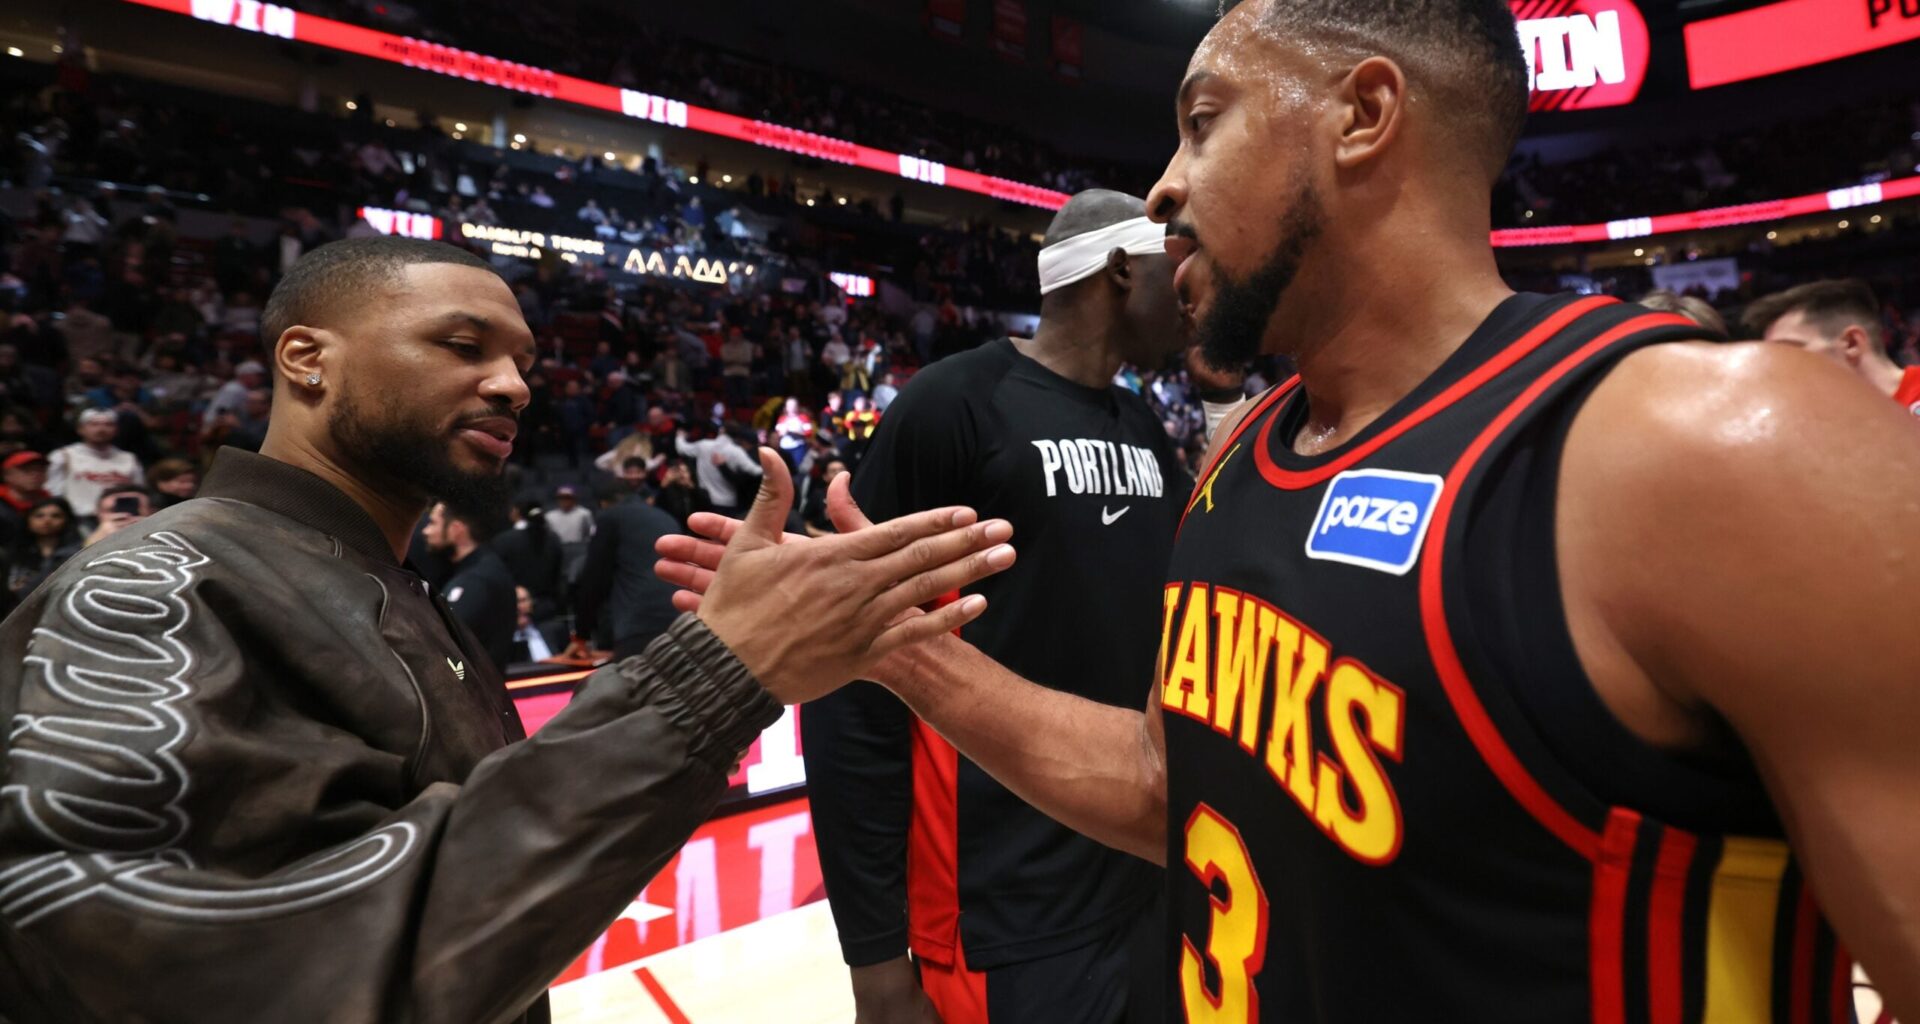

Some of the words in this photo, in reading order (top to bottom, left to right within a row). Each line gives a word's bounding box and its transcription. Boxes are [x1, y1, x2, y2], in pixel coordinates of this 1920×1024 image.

[190, 0, 296, 39] WIN
[1516, 8, 1626, 91] IN
[621, 88, 688, 127] WIN
[899, 154, 946, 185] WIN
[1030, 438, 1164, 498] PORTLAND
[1320, 495, 1419, 535] paze
[0, 531, 211, 872] didas
[1179, 801, 1270, 1024] 3
